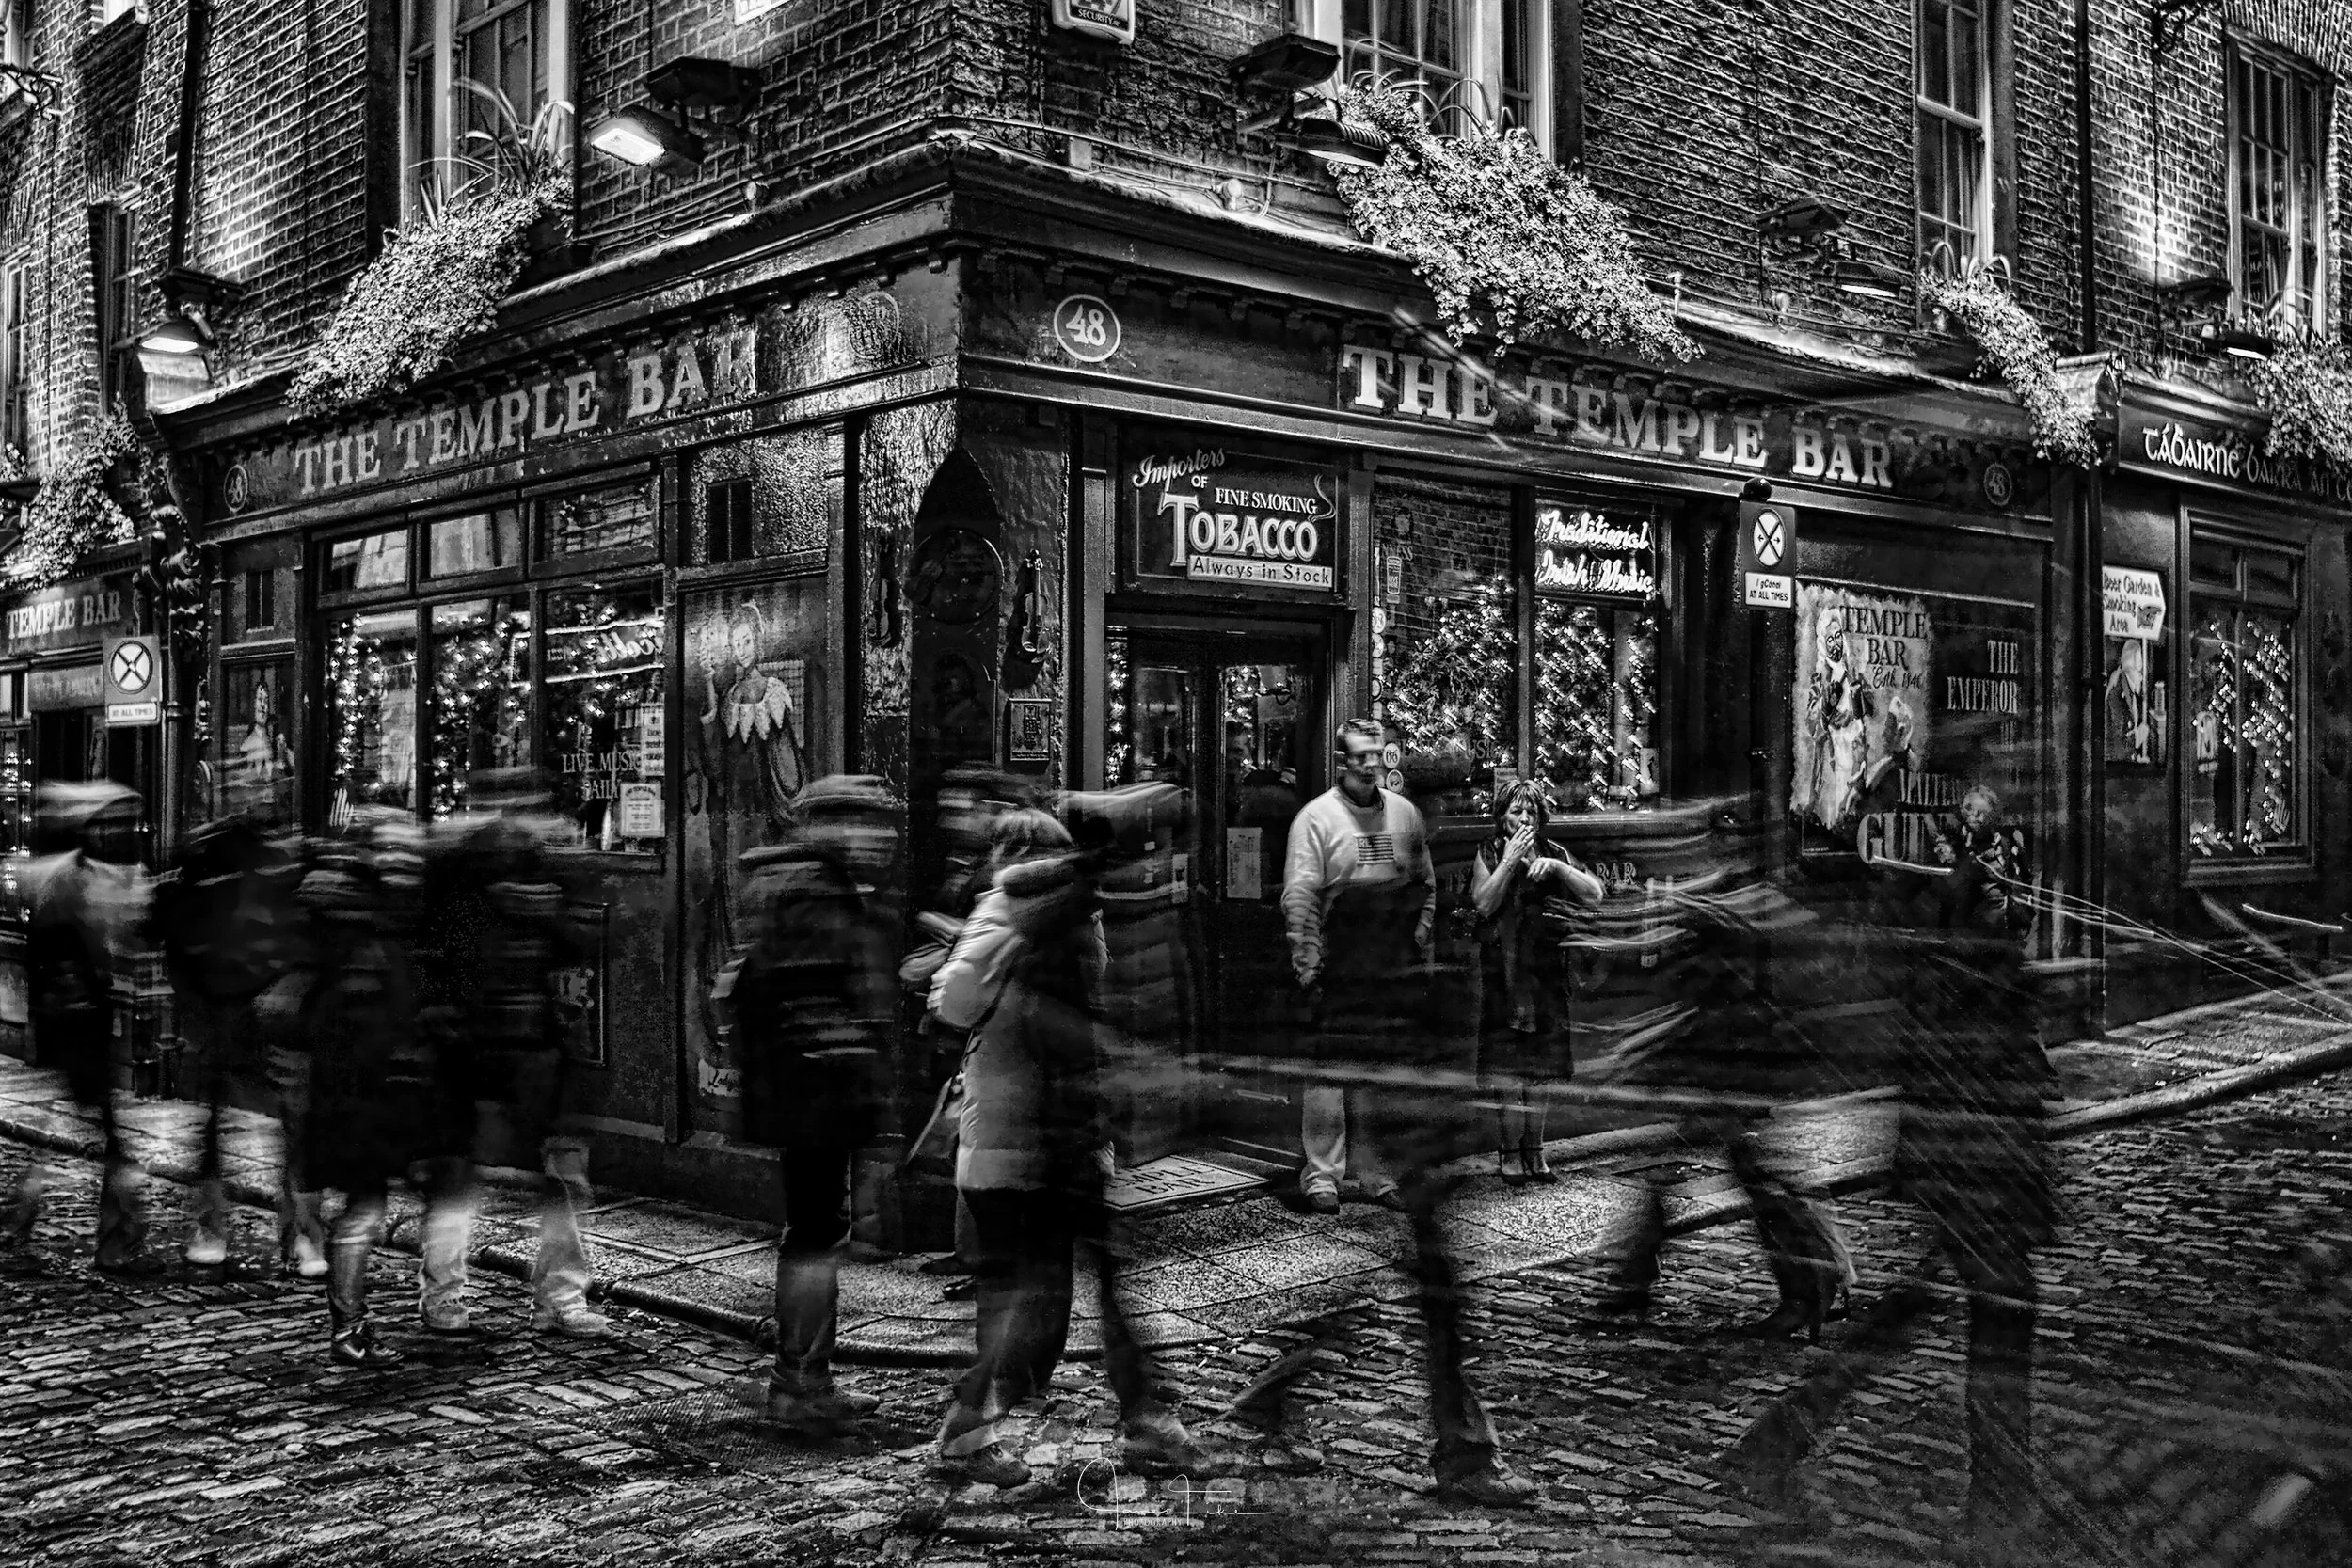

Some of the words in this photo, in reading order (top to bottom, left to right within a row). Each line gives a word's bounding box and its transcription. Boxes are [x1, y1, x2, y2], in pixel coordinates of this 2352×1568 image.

[1077, 8, 1114, 25] SECURITY
[1065, 304, 1107, 347] 48
[294, 429, 381, 495] THE
[396, 370, 600, 471] TEMPLE
[627, 326, 757, 420] BAR
[1343, 343, 1499, 427] THE
[1525, 375, 1770, 468] TEMPLE
[1791, 425, 1894, 489] BAR
[1132, 447, 1227, 492] Importers
[1190, 473, 1209, 489] OF
[1215, 486, 1250, 508] FINE
[1251, 491, 1318, 515] SMOKING
[1157, 492, 1319, 567] TOBACCO
[1540, 509, 1650, 550] Traditional
[1192, 556, 1253, 578] Always
[1262, 562, 1277, 579] in
[1283, 563, 1330, 585] Stock
[2123, 575, 2153, 597] Garden
[1749, 589, 1756, 598] AT
[1758, 590, 1769, 600] ALL
[1771, 592, 1788, 602] TIMES
[7, 597, 75, 640] TEMPLE
[82, 590, 122, 626] BAR
[1839, 605, 1929, 640] TEMPLE
[2109, 613, 2129, 633] Area
[1866, 637, 1909, 672] BAR
[1987, 640, 2019, 675] THE
[1946, 675, 2019, 714] EMPEROR
[561, 752, 595, 774] LIVE
